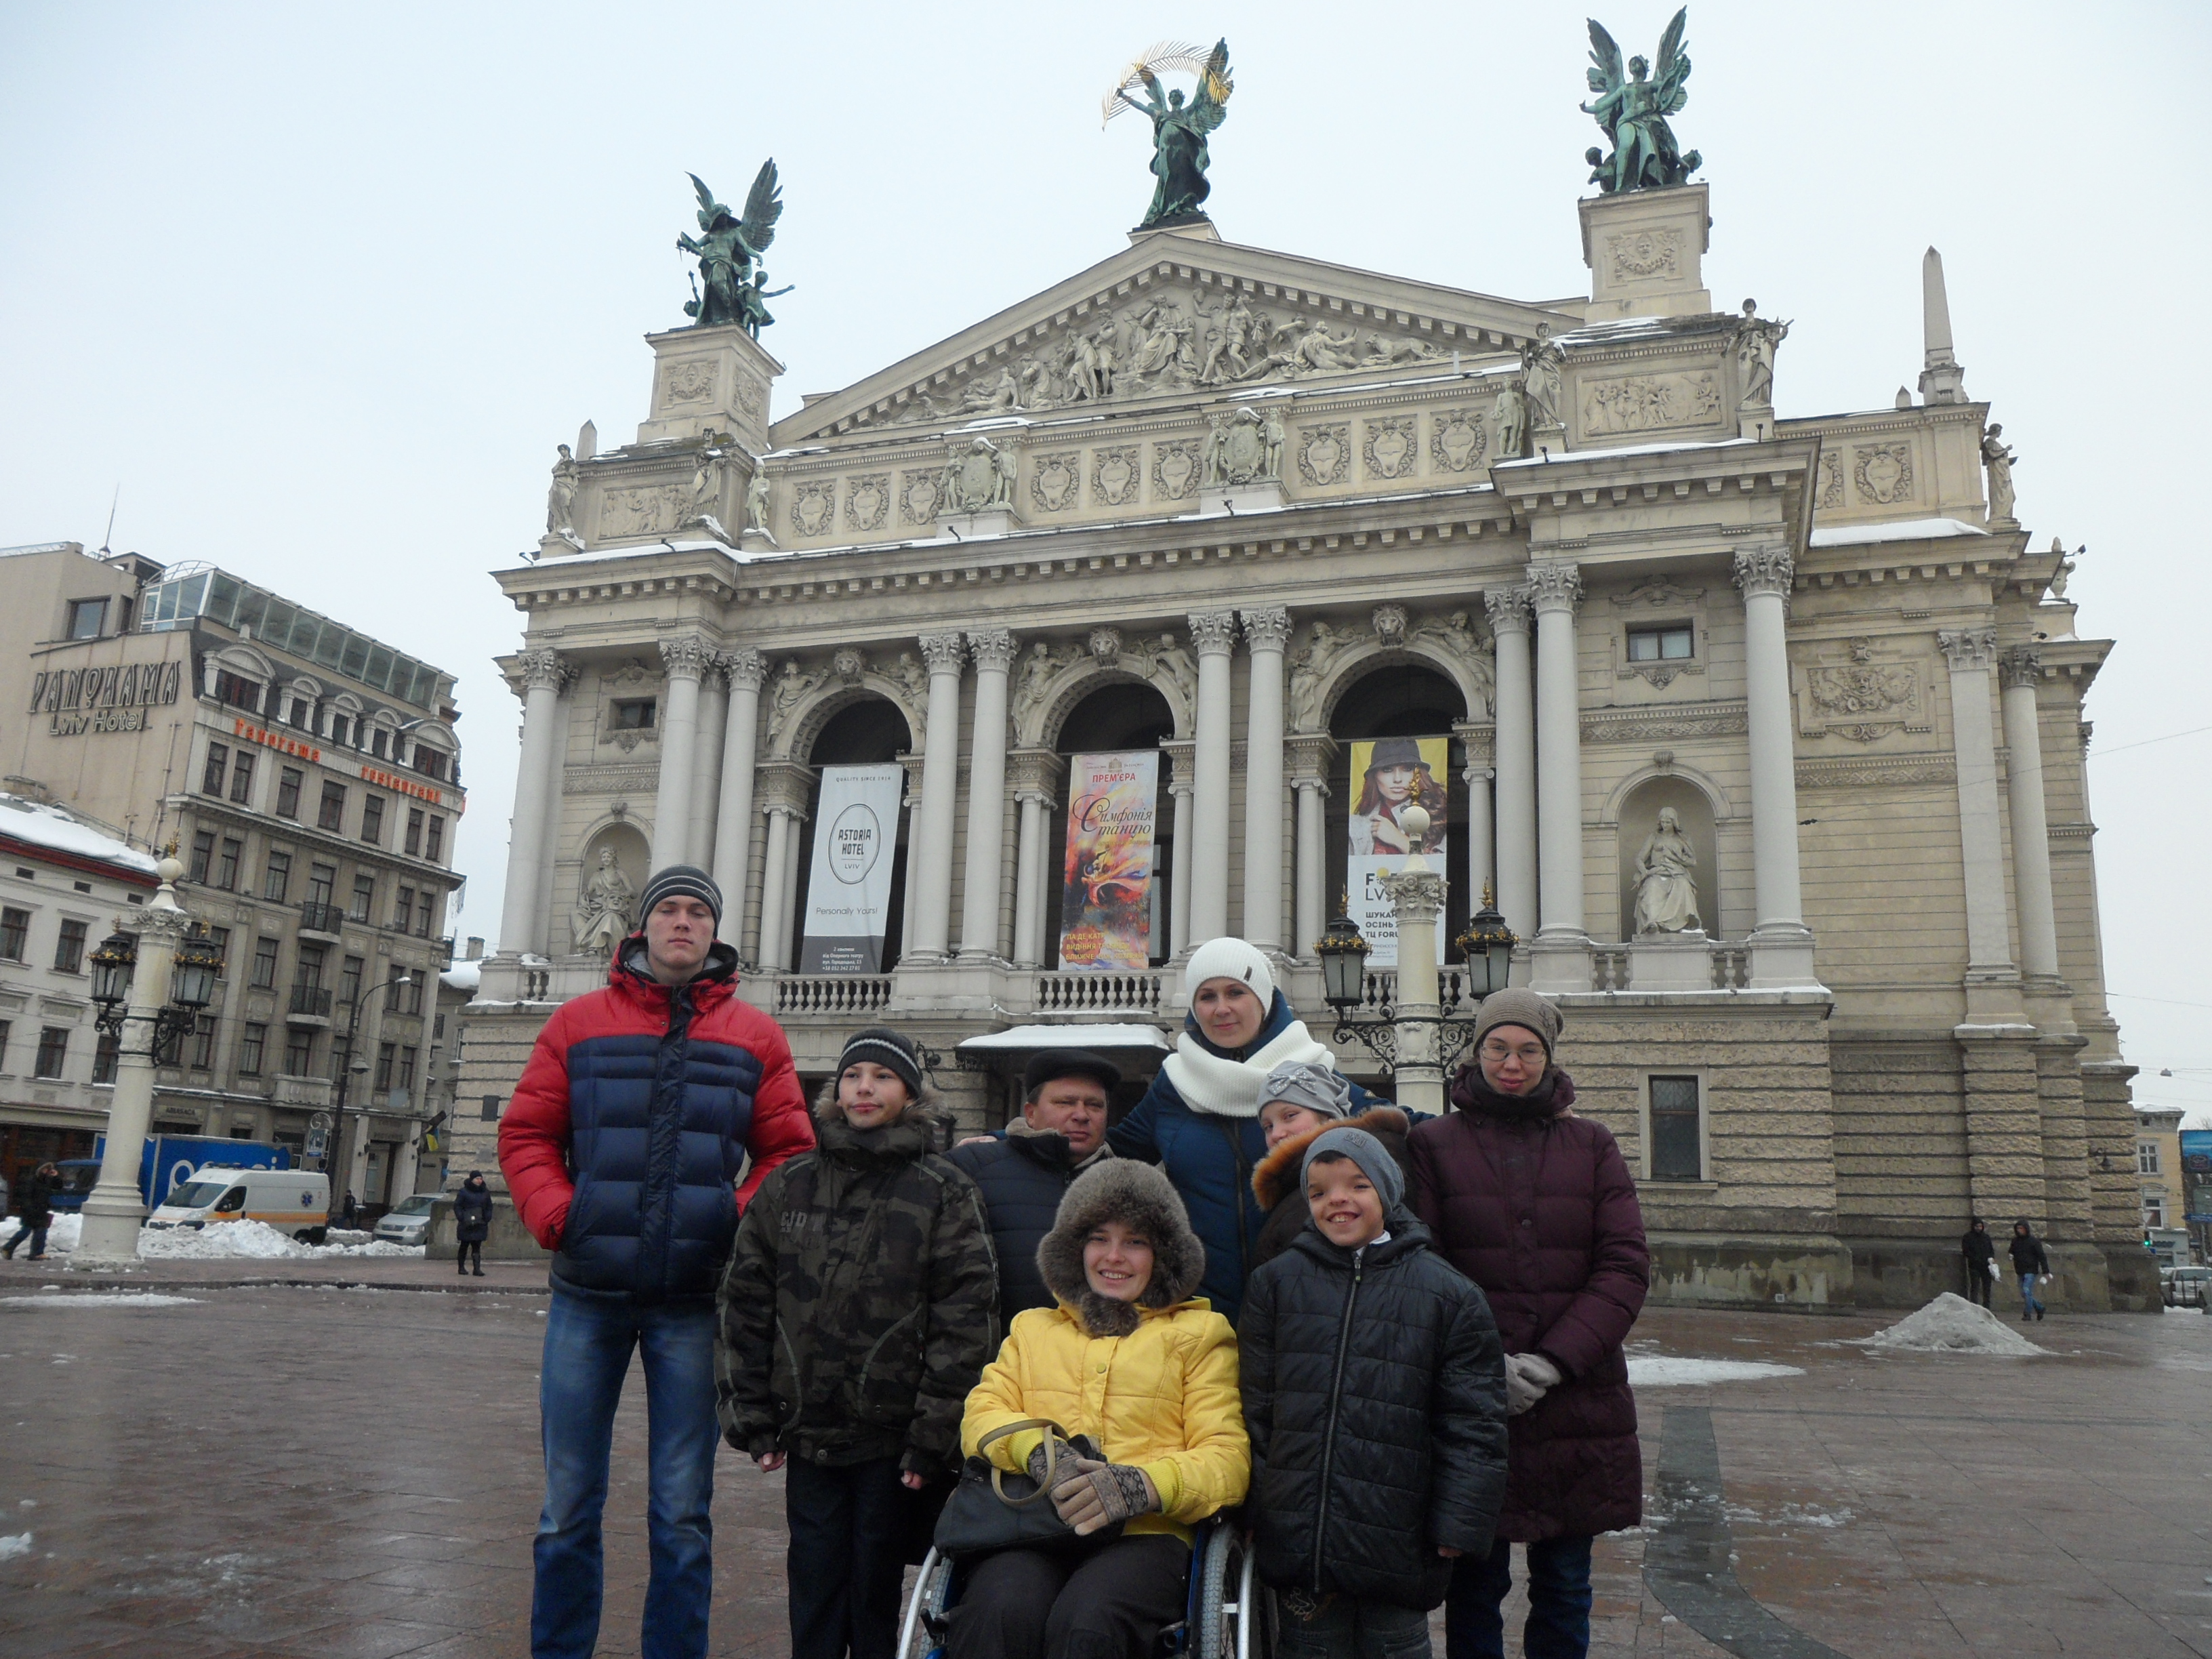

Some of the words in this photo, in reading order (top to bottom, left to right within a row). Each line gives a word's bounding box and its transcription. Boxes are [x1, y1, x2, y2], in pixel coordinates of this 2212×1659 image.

[29, 661, 181, 713] PANORAMA
[49, 714, 89, 736] Lviv
[93, 708, 146, 733] Hotel
[234, 718, 321, 762] Panorama
[361, 766, 441, 804] restaurant
[1092, 773, 1136, 783] ПРЕМ'ЄРА
[1073, 794, 1152, 832] Симфонія
[838, 829, 871, 840] ASTORIA
[1098, 824, 1151, 839] танцю
[842, 843, 864, 855] HOTEL
[816, 907, 854, 916] Personally
